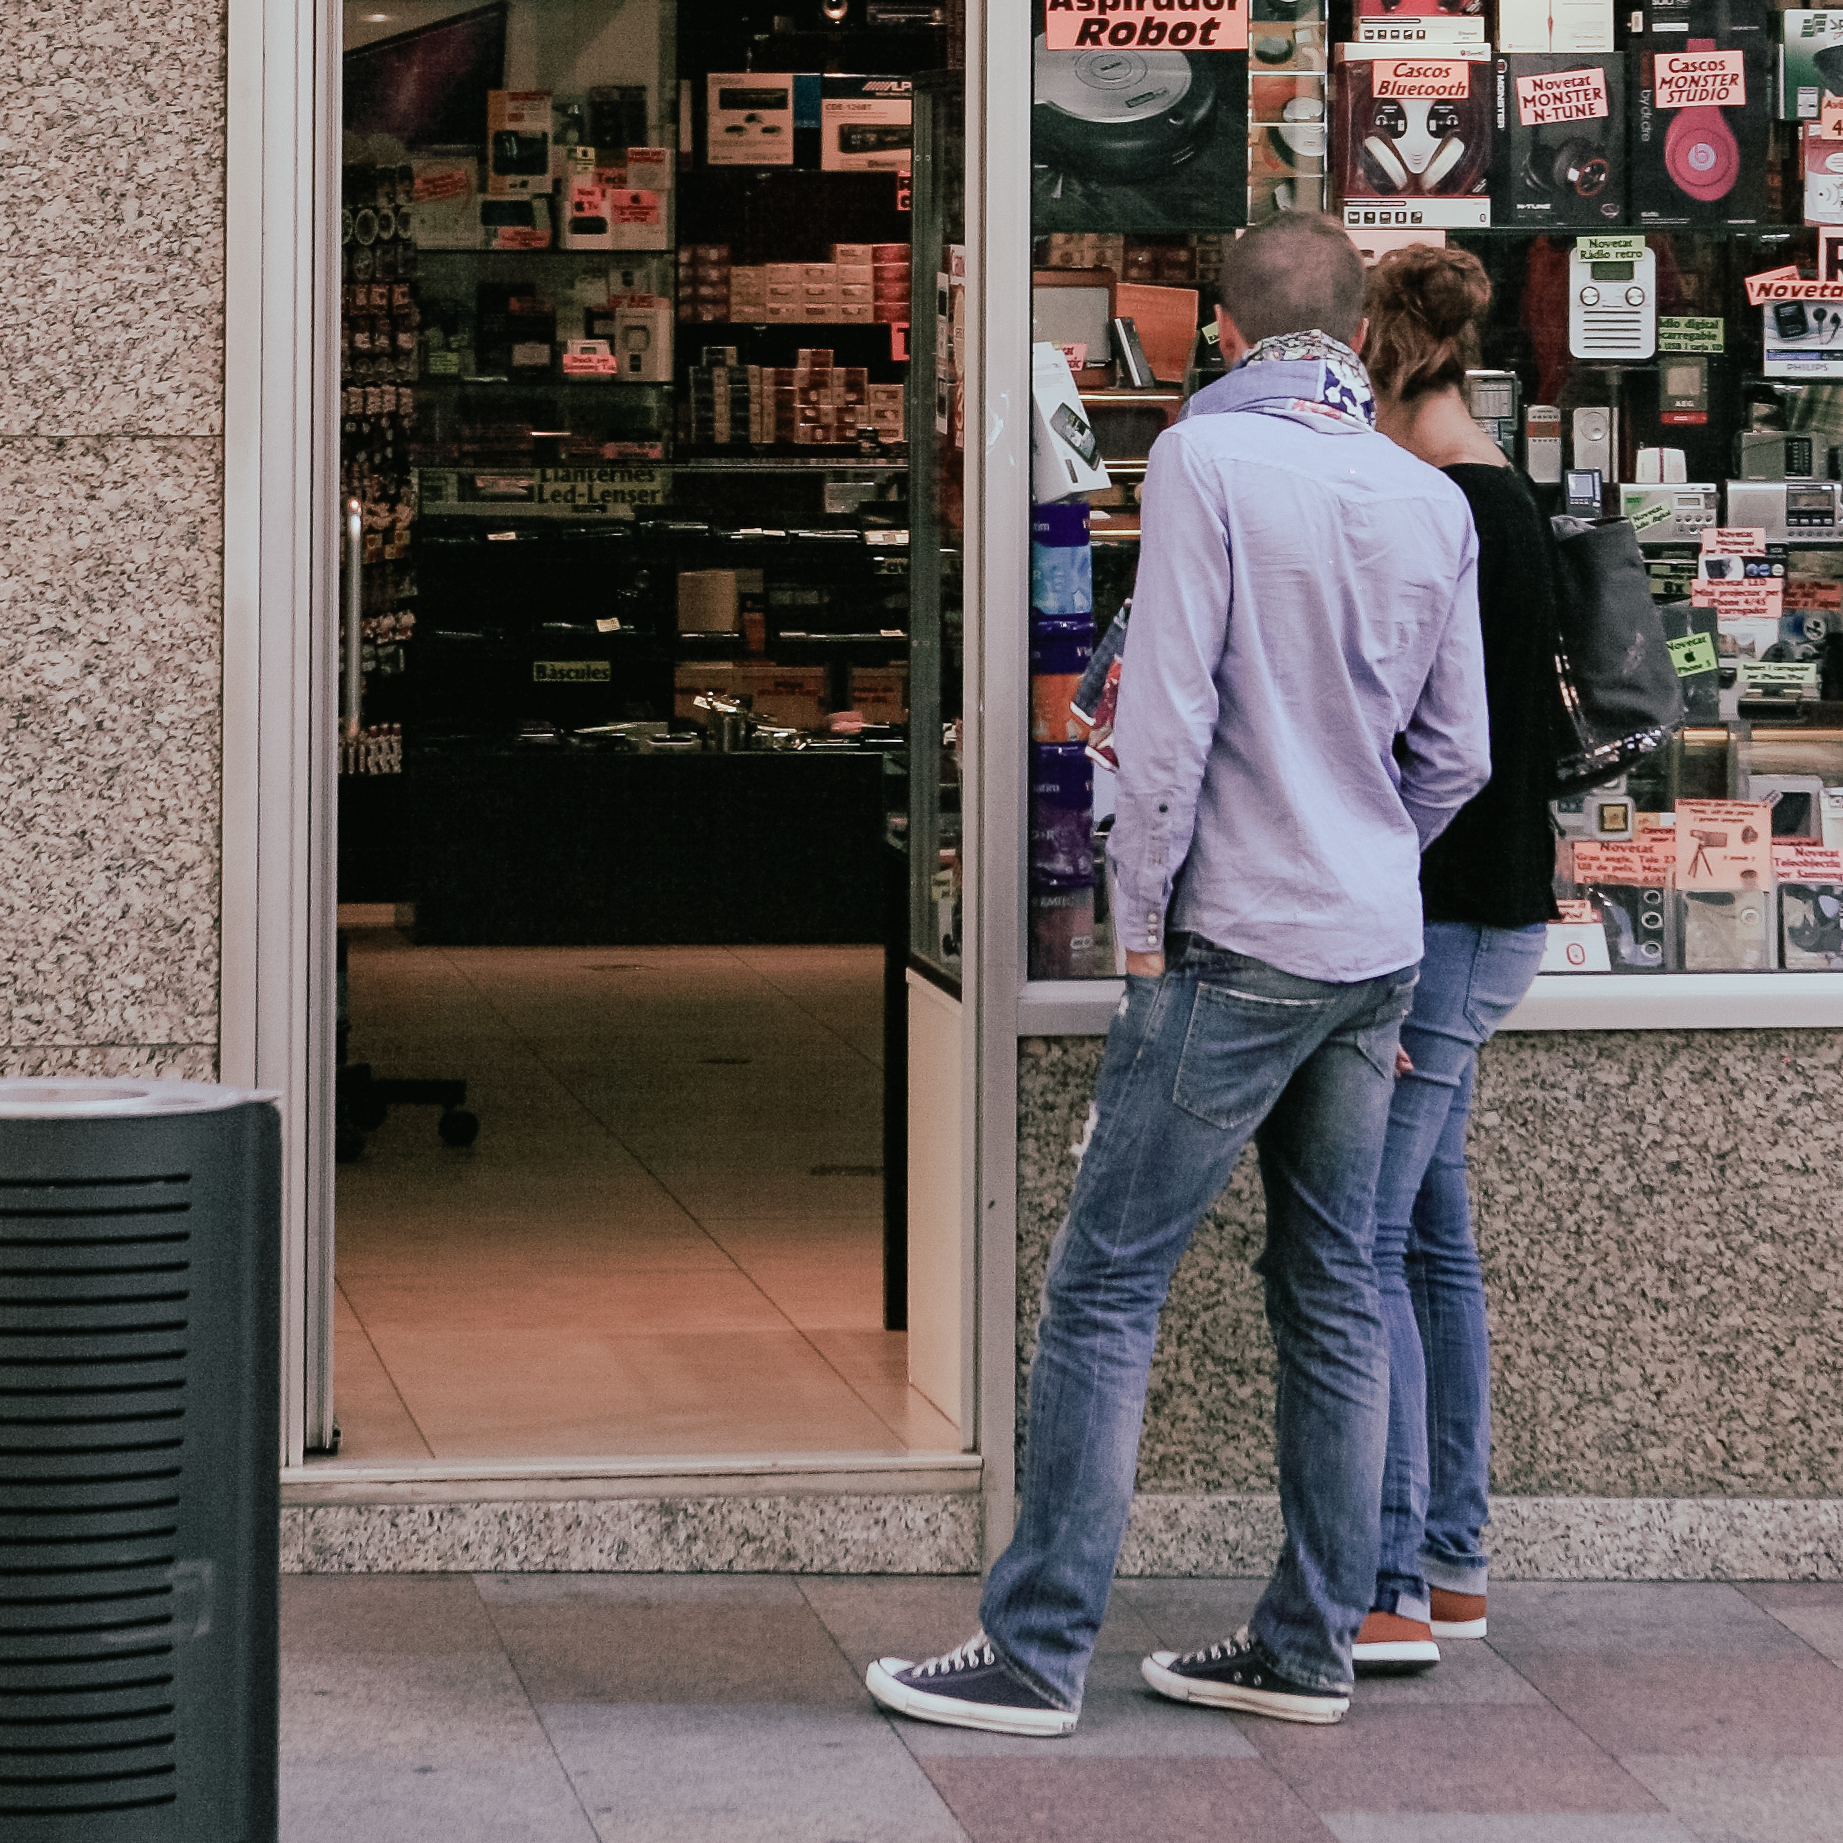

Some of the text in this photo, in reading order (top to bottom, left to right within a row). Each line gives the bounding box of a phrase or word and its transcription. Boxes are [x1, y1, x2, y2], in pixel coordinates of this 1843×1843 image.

[1076, 18, 1221, 47] Robot
[1393, 63, 1451, 79] Cascos
[1668, 58, 1725, 73] Cascos
[1378, 80, 1467, 97] Bluetooth
[1532, 75, 1591, 91] Novetat
[1660, 74, 1739, 91] MONSTER
[1523, 89, 1603, 109] MONSTER
[1669, 87, 1729, 103] STUDIO
[1535, 103, 1596, 122] N-TUNE
[537, 485, 662, 506] Led-Lenser
[536, 663, 609, 681] Bàscules
